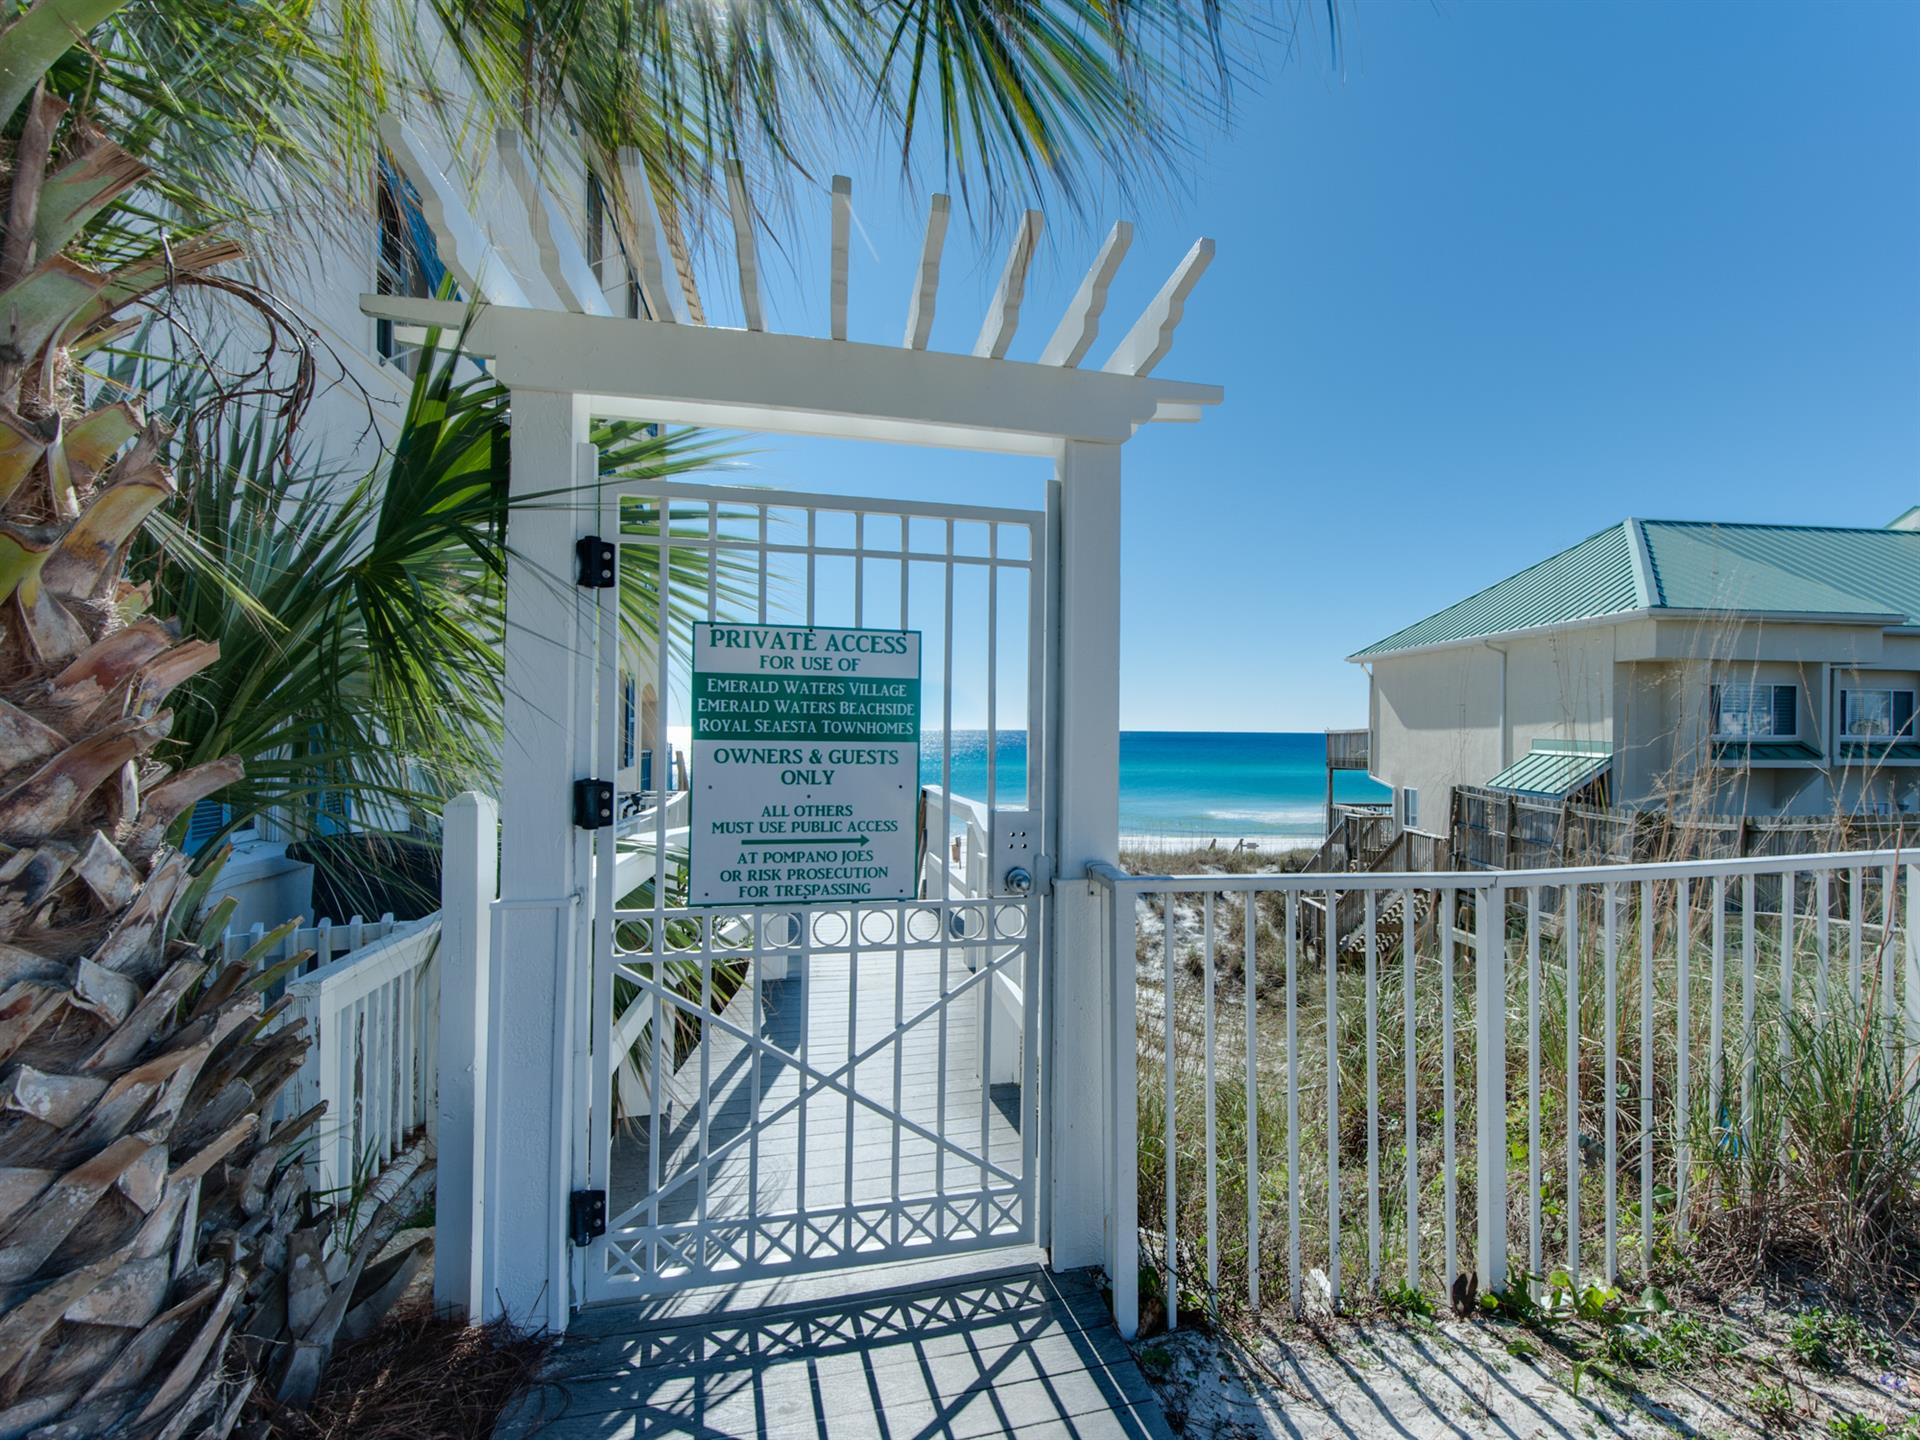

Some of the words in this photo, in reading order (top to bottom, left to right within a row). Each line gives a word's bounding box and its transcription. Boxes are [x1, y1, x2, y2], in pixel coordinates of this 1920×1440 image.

[710, 629, 816, 651] PRIVATE
[825, 634, 908, 654] ACCESS
[760, 655, 794, 669] FOR
[801, 657, 832, 671] USE
[838, 658, 860, 671] OF
[707, 678, 778, 694] EMERALD
[783, 680, 844, 695] WATERS
[850, 682, 907, 697] VILLAGE
[698, 698, 769, 713] EMERALD
[774, 700, 836, 714] WATERS
[840, 702, 914, 716] BEACHSIDE
[699, 719, 749, 733] ROYAL
[755, 719, 816, 733] SEAESTA
[821, 720, 913, 735] TOWNHOMES
[714, 749, 803, 764] OWNERS
[809, 749, 822, 764] &
[829, 749, 898, 765] GUESTS
[781, 770, 835, 785] ONLY
[761, 806, 789, 817] ALL
[794, 805, 853, 817] OTHERS
[712, 822, 753, 834] MUST
[759, 822, 786, 833] USE
[792, 821, 842, 833] PUBLIC
[848, 821, 898, 832] ACCESS
[737, 852, 758, 864] AT
[763, 851, 837, 864] POMPANO
[842, 851, 873, 865] JOES
[720, 870, 742, 882] OR
[747, 869, 781, 881] RISK
[787, 867, 888, 881] PROSECUTION
[739, 886, 769, 898] FOR
[775, 883, 870, 897] TRESPASSING
